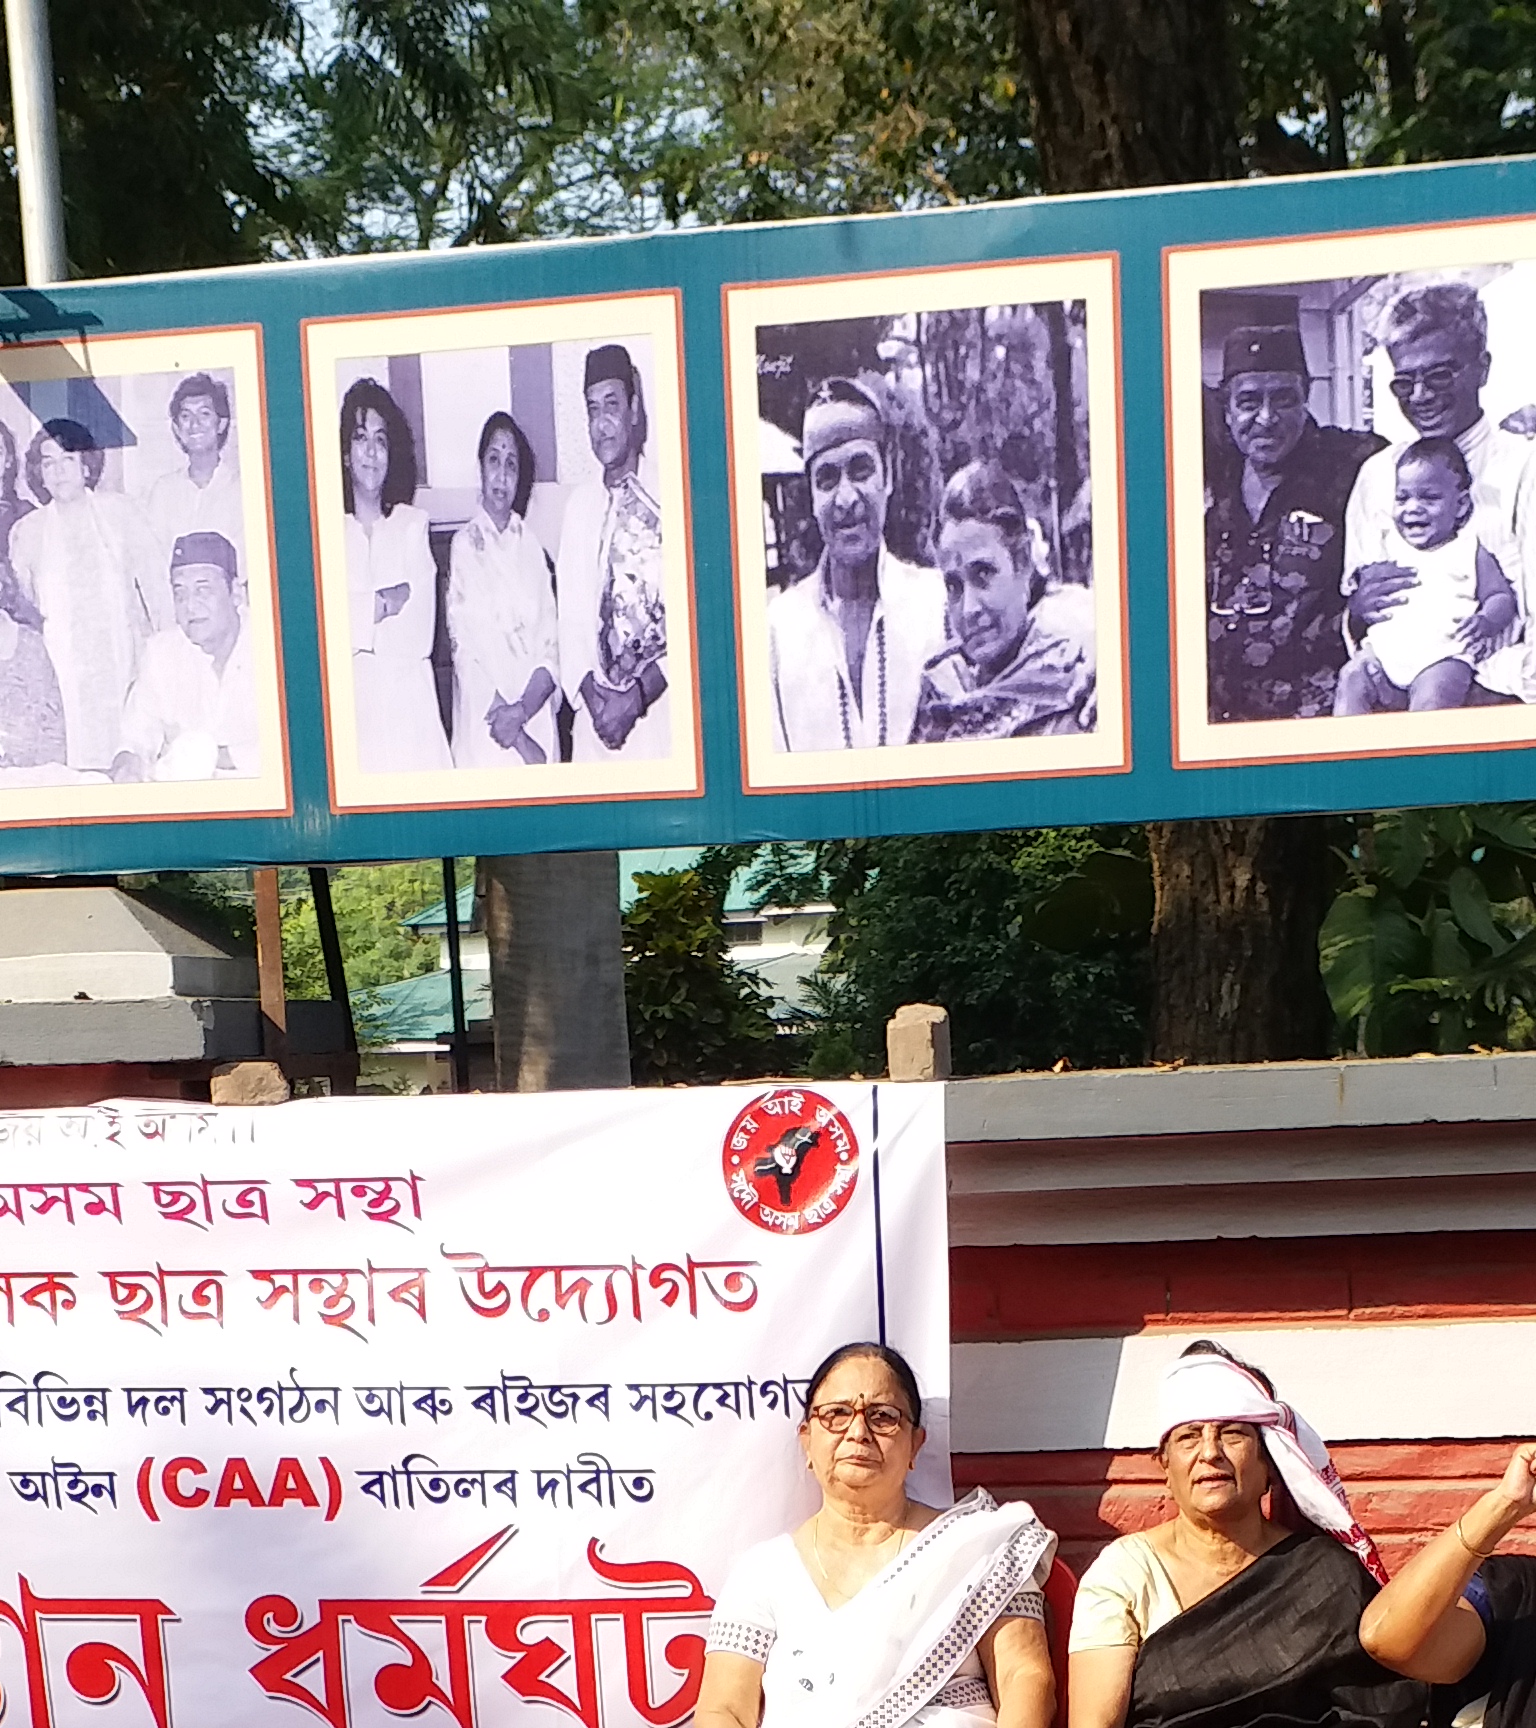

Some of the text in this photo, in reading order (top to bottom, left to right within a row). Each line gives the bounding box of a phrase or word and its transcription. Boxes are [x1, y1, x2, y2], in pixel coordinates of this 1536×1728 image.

[290, 1169, 426, 1234] সন্থা
[246, 1258, 430, 1344] সন্থাৰ
[440, 1243, 761, 1325] উদ্যোগত
[121, 1387, 188, 1427] দল
[199, 1367, 342, 1426] সংগঠন
[352, 1380, 453, 1426] আৰু
[464, 1369, 612, 1429] ৰাইজৰ
[6, 1456, 118, 1515] আইন
[137, 1456, 342, 1522] (CAA)
[354, 1454, 519, 1510] বাতিলৰ
[530, 1452, 656, 1509] দাবীত
